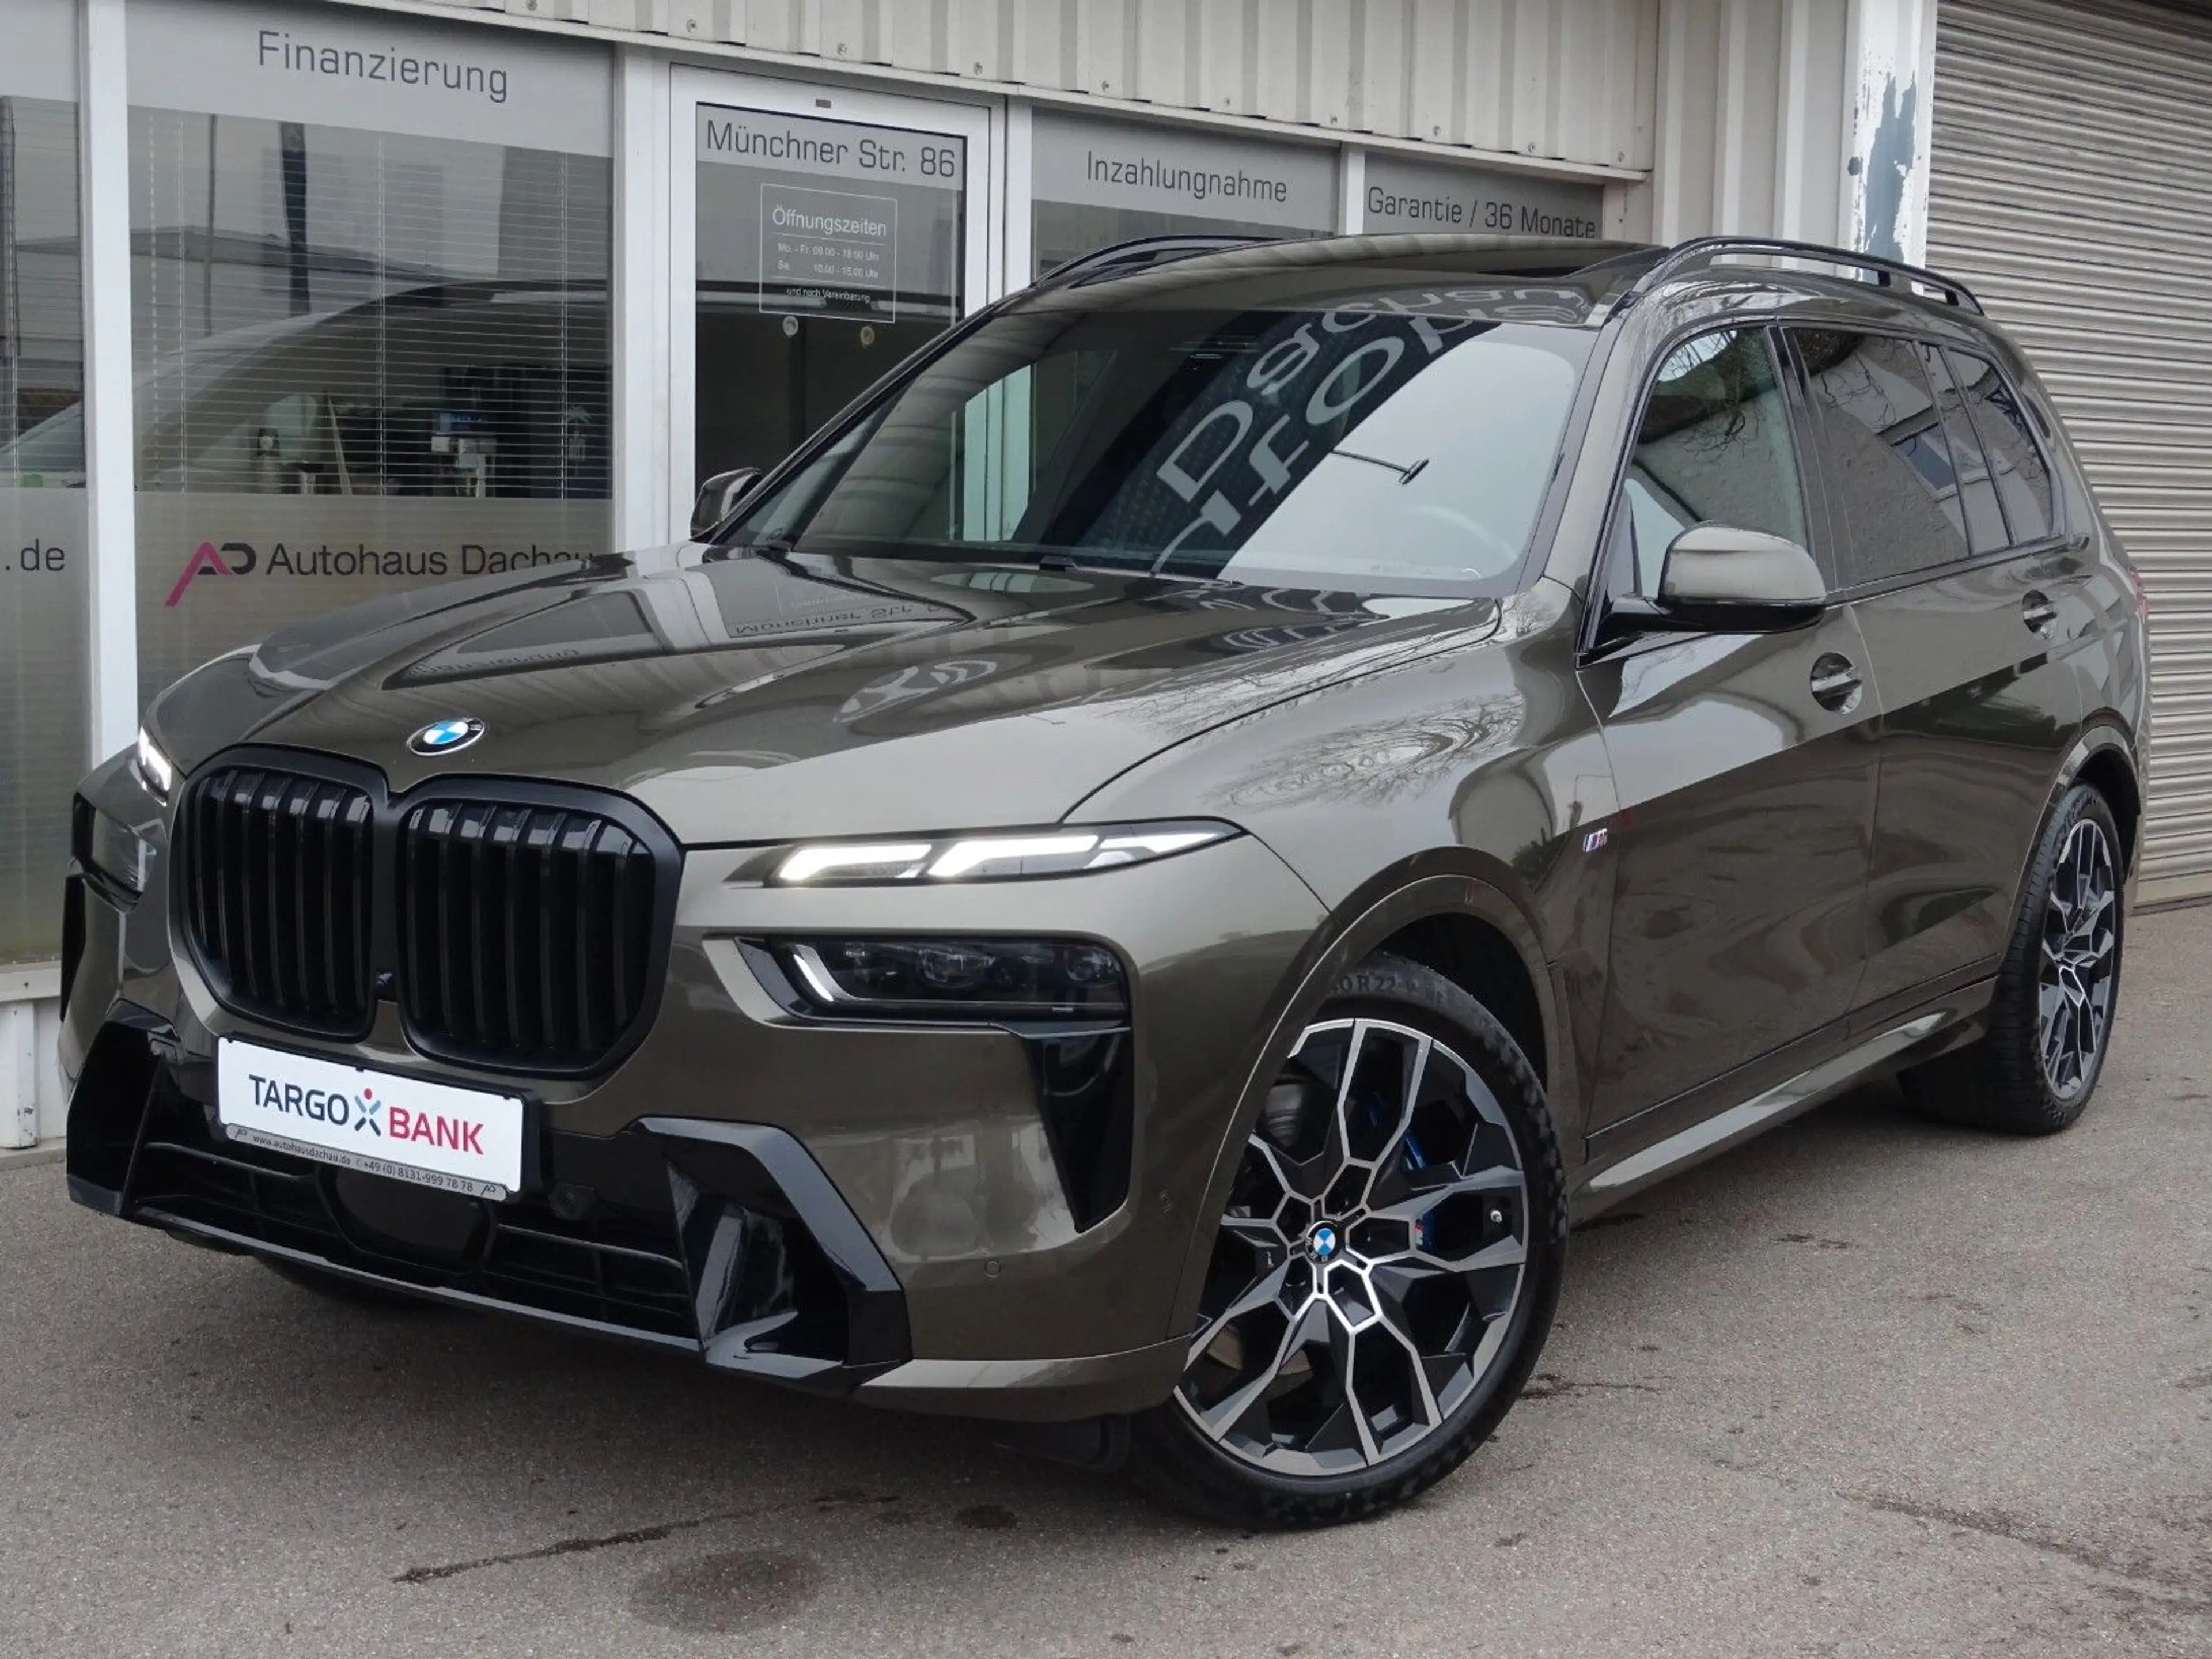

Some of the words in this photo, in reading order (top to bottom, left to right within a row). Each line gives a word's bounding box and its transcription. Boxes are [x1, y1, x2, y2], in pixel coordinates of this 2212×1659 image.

[259, 31, 509, 103] Finanzierung
[707, 119, 849, 164] Münchner
[859, 139, 906, 172] Str.
[921, 147, 955, 177] 86
[1087, 150, 1287, 203] Inzahlungnahme
[772, 204, 887, 236] Öffnungszeiten
[1368, 187, 1462, 223] Garantie
[1469, 200, 1478, 228] /
[1485, 202, 1512, 229] 36
[1521, 206, 1595, 238] Monate
[786, 287, 801, 296] und
[803, 288, 820, 297] nach
[822, 289, 871, 304] Vereinbarung
[266, 543, 448, 576] Autohaus
[462, 544, 592, 575] Dach
[248, 1074, 350, 1126] TARGO
[389, 1106, 484, 1156] BANK
[382, 1162, 396, 1176] (0)
[398, 1168, 443, 1185] 8131-999
[447, 1177, 459, 1188] 78
[462, 1182, 473, 1192] 78
